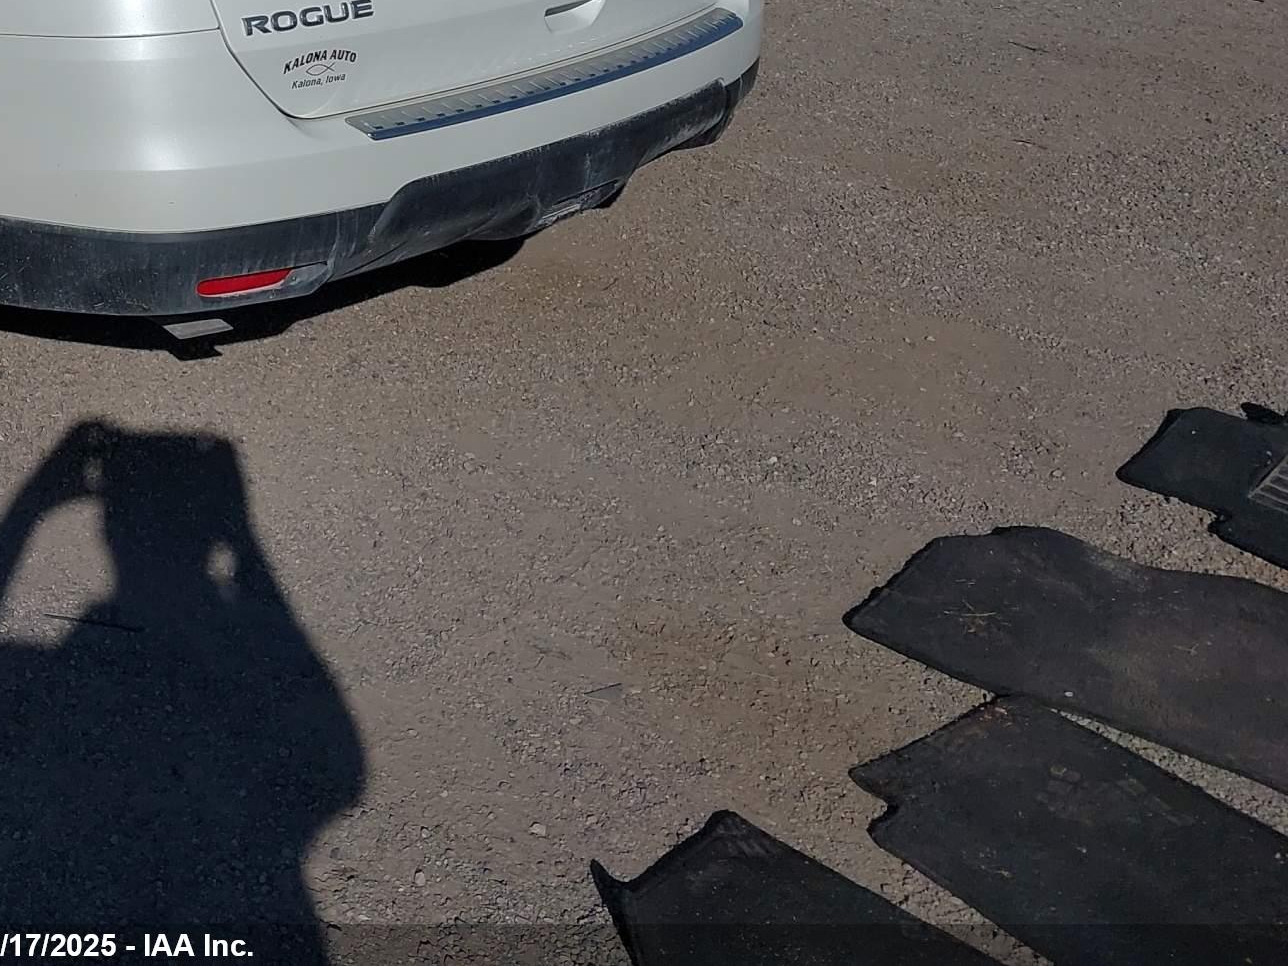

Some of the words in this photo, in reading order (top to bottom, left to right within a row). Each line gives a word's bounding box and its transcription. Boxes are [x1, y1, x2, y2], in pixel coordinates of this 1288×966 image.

[283, 50, 328, 75] KALONA
[329, 49, 357, 63] AUTO
[291, 78, 324, 90] Kalona,
[325, 73, 347, 84] Iowa
